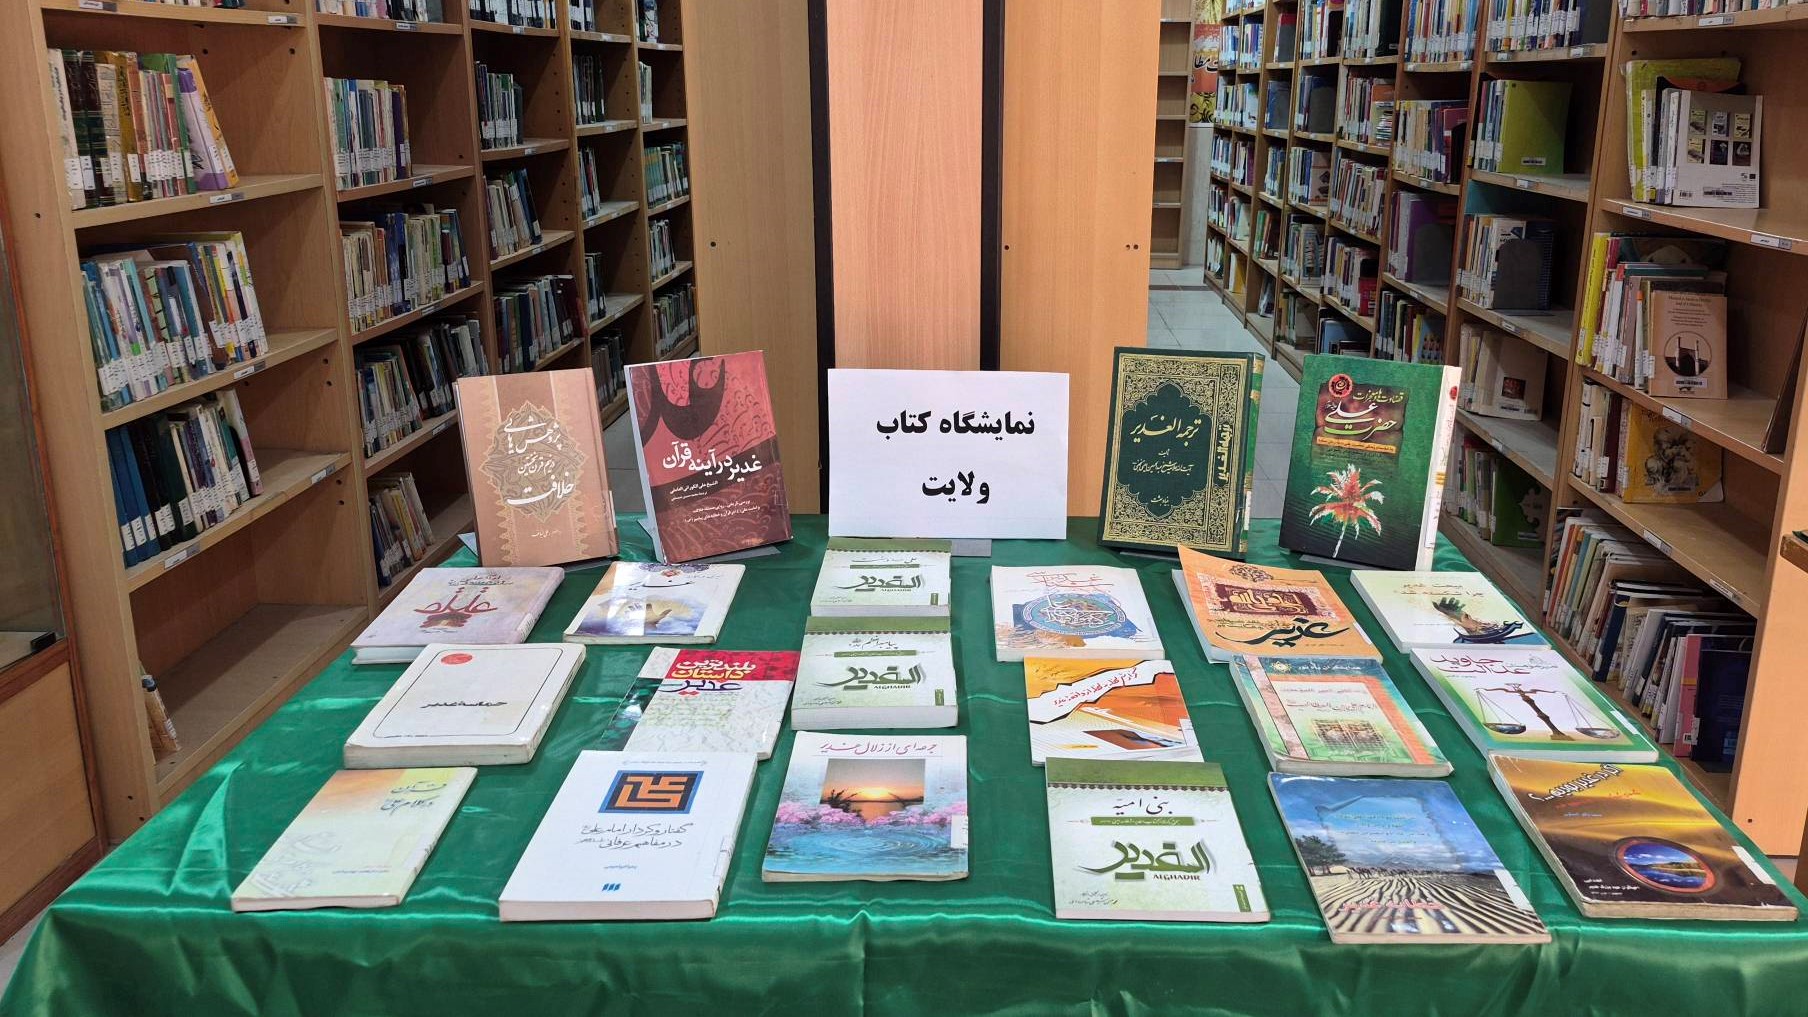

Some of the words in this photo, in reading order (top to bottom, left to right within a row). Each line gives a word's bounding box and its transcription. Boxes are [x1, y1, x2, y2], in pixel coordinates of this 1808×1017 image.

[1325, 401, 1378, 424] علی
[876, 410, 932, 440] کتاب
[939, 410, 1035, 441] نمایشگاه
[1130, 414, 1182, 443] الغدیر
[1324, 418, 1397, 441] حضرت
[663, 441, 692, 469] قرآن
[689, 449, 717, 476] آینه
[716, 455, 733, 474] در
[728, 454, 762, 482] غدیر
[507, 471, 575, 505] خلافت
[922, 470, 990, 504] ولایت
[1215, 617, 1350, 648] غدیر
[676, 659, 757, 674] بلندترین
[1429, 653, 1504, 668] جاوید
[1438, 664, 1531, 675] عدالت
[671, 669, 745, 680] داستان
[658, 679, 743, 696] غدیر
[820, 741, 859, 753] غدیر
[856, 740, 885, 755] زلال
[1146, 796, 1173, 815] بنی
[664, 823, 694, 834] گفتار
[658, 840, 683, 849] در
[1079, 841, 1210, 880] الغدیر
